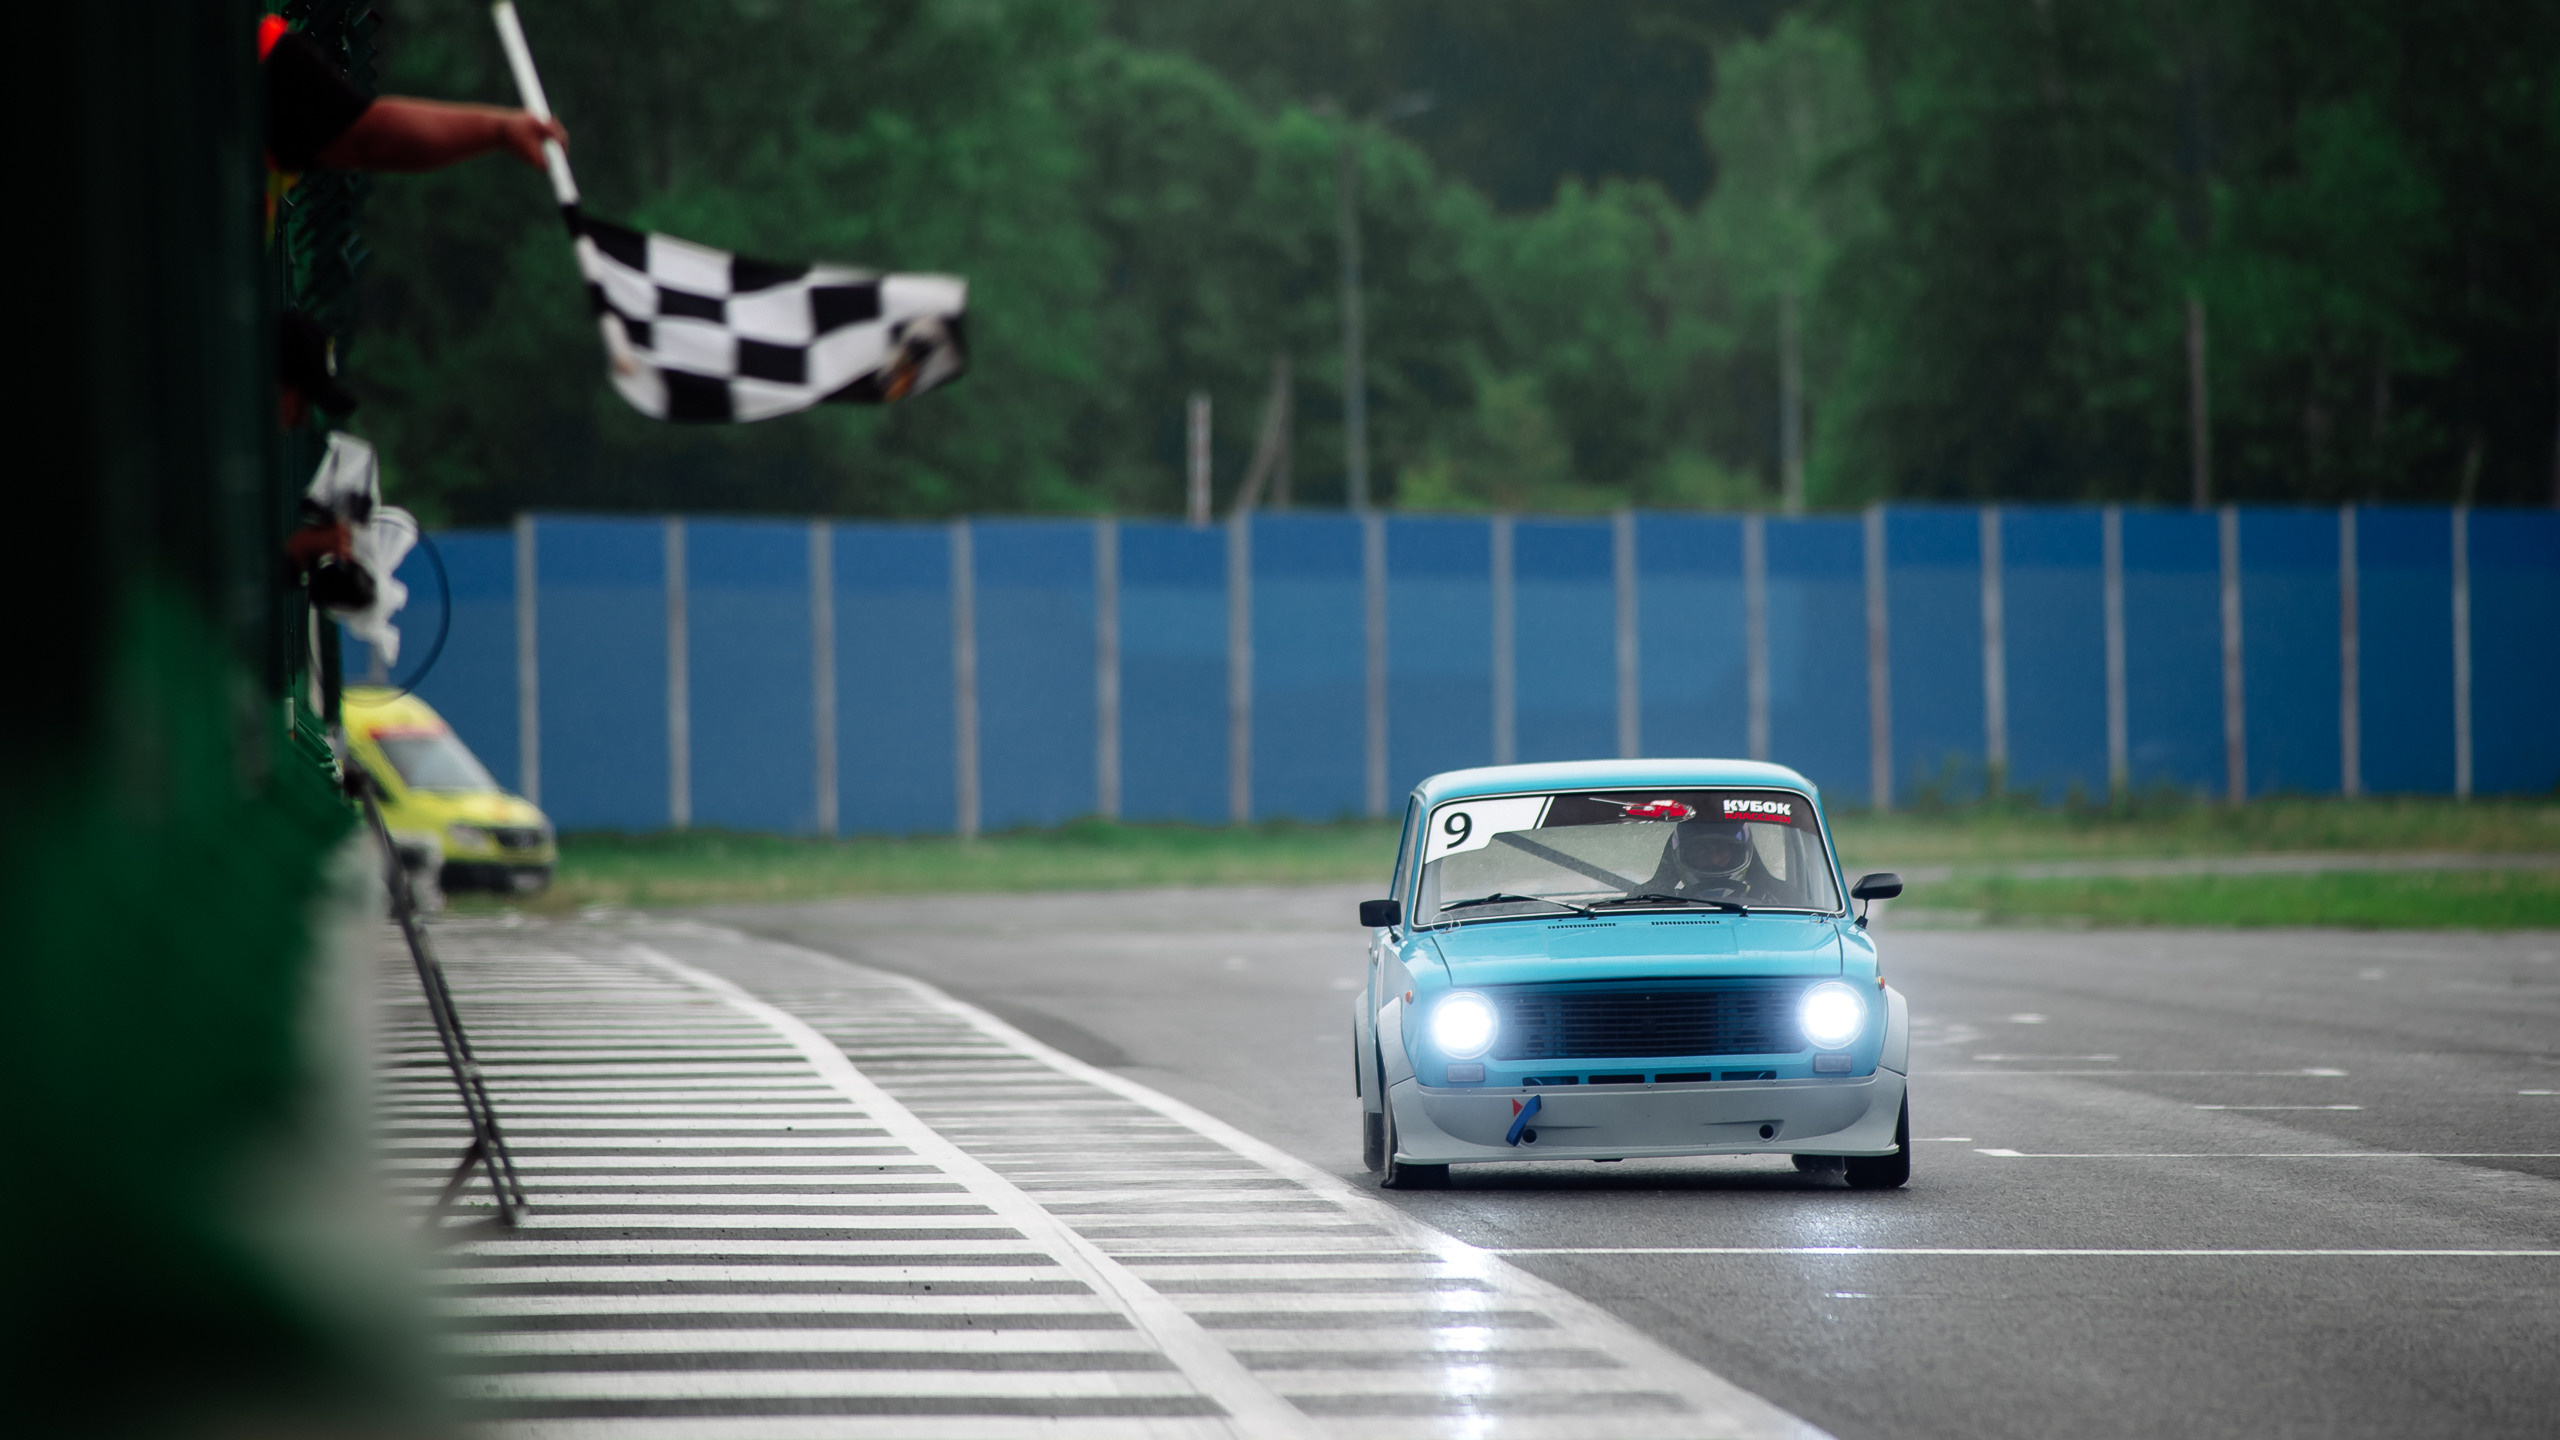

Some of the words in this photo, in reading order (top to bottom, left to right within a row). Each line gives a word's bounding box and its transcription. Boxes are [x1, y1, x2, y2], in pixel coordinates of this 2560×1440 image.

[1723, 799, 1792, 816] КУБОК
[1724, 812, 1791, 824] КЛАССИКИ
[1444, 811, 1473, 850] 9
